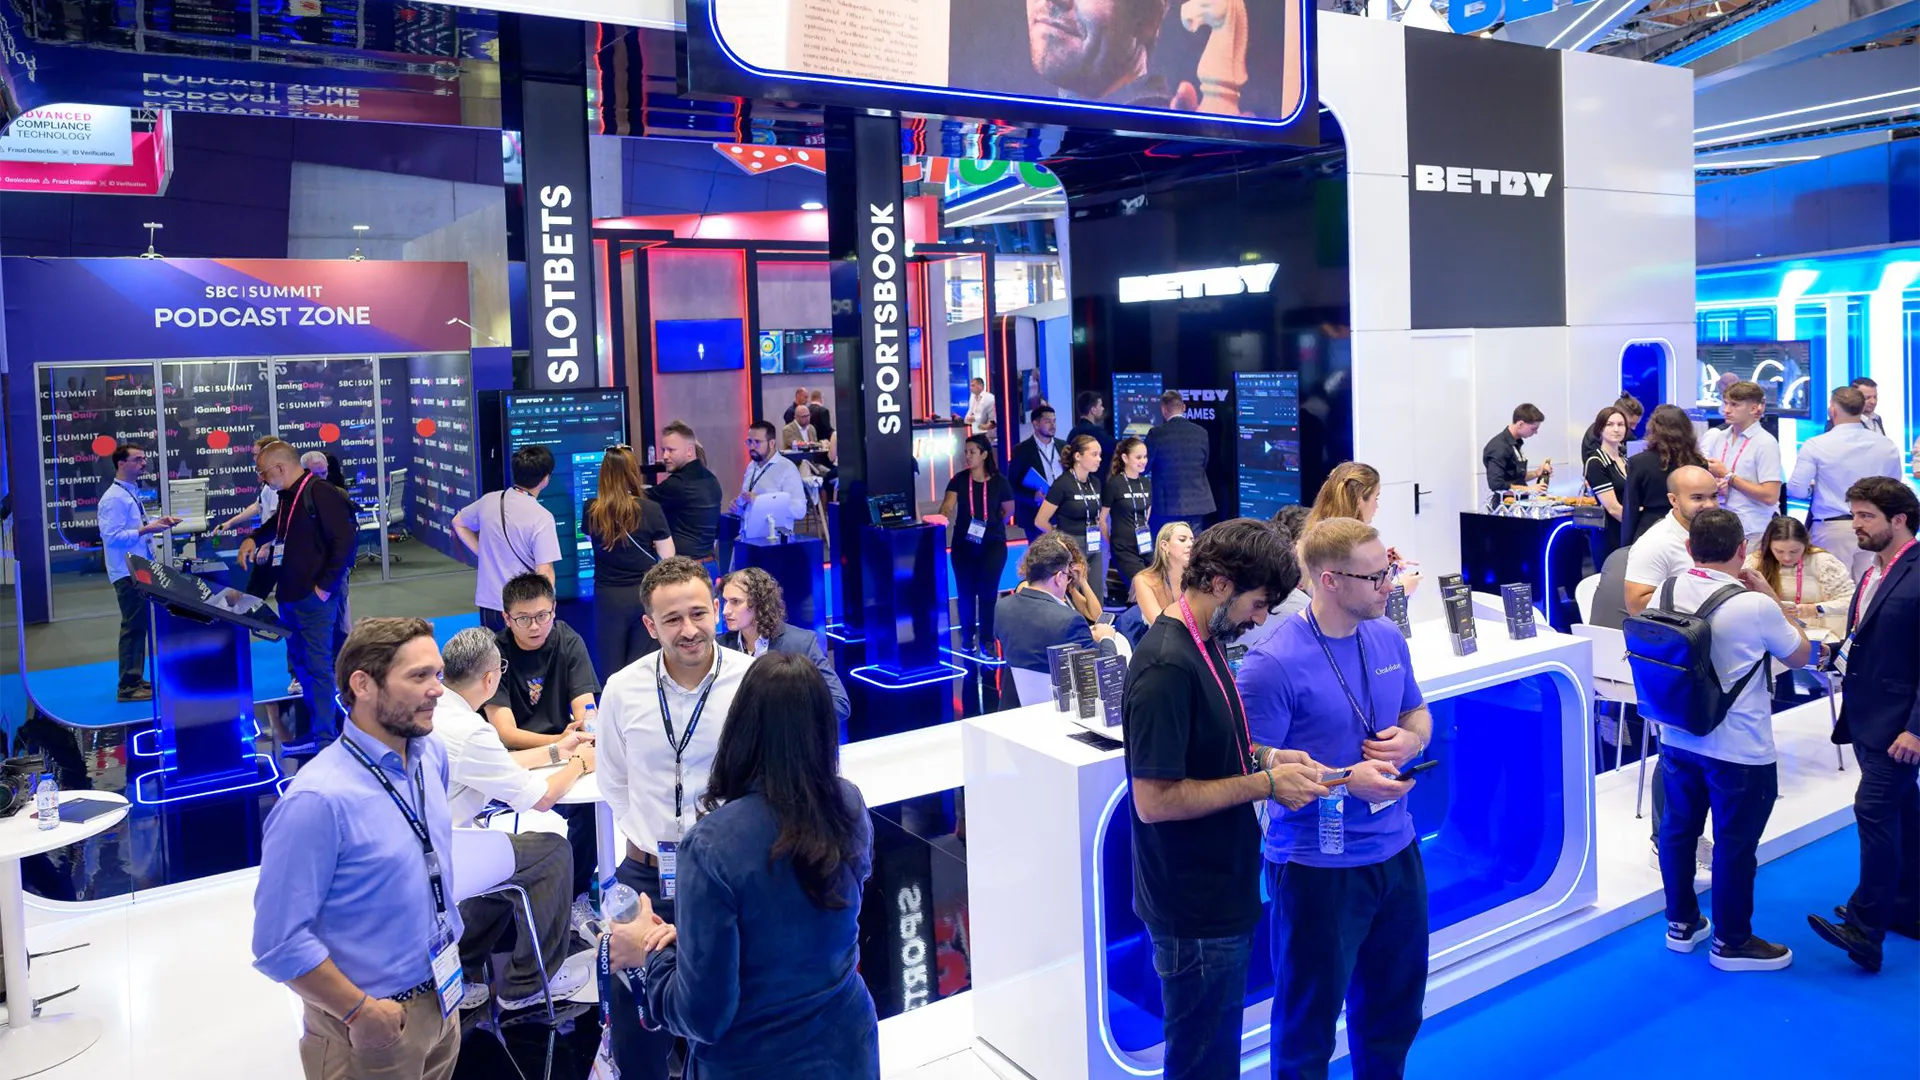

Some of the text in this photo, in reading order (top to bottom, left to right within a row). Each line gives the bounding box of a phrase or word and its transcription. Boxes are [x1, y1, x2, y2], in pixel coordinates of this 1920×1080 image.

[16, 120, 91, 131] COMPLIANCE
[17, 130, 92, 141] TECHNOLOGY
[1415, 164, 1553, 197] BETBY
[540, 185, 579, 383] SLOTBETS
[1119, 263, 1280, 303] BETBY
[205, 285, 323, 299] SBC SUMMIT
[155, 306, 371, 328] PODCAST ZONE
[870, 203, 901, 435] SPORTSBOOK
[193, 384, 253, 393] SBC SUMMIT
[277, 382, 324, 391] amingDaily
[55, 390, 97, 398] SUMMIT
[1165, 389, 1229, 401] ETBY
[289, 401, 325, 409] SUMMIT
[42, 412, 98, 421] amingDaily
[115, 409, 133, 417] SBC
[57, 433, 100, 442] SUMMIT
[45, 454, 99, 464] amingDaily
[198, 466, 257, 476] SBC SUMMIT
[59, 476, 101, 485] SUMMIT
[62, 519, 98, 529] SUMMI
[601, 934, 610, 975] LOOKING
